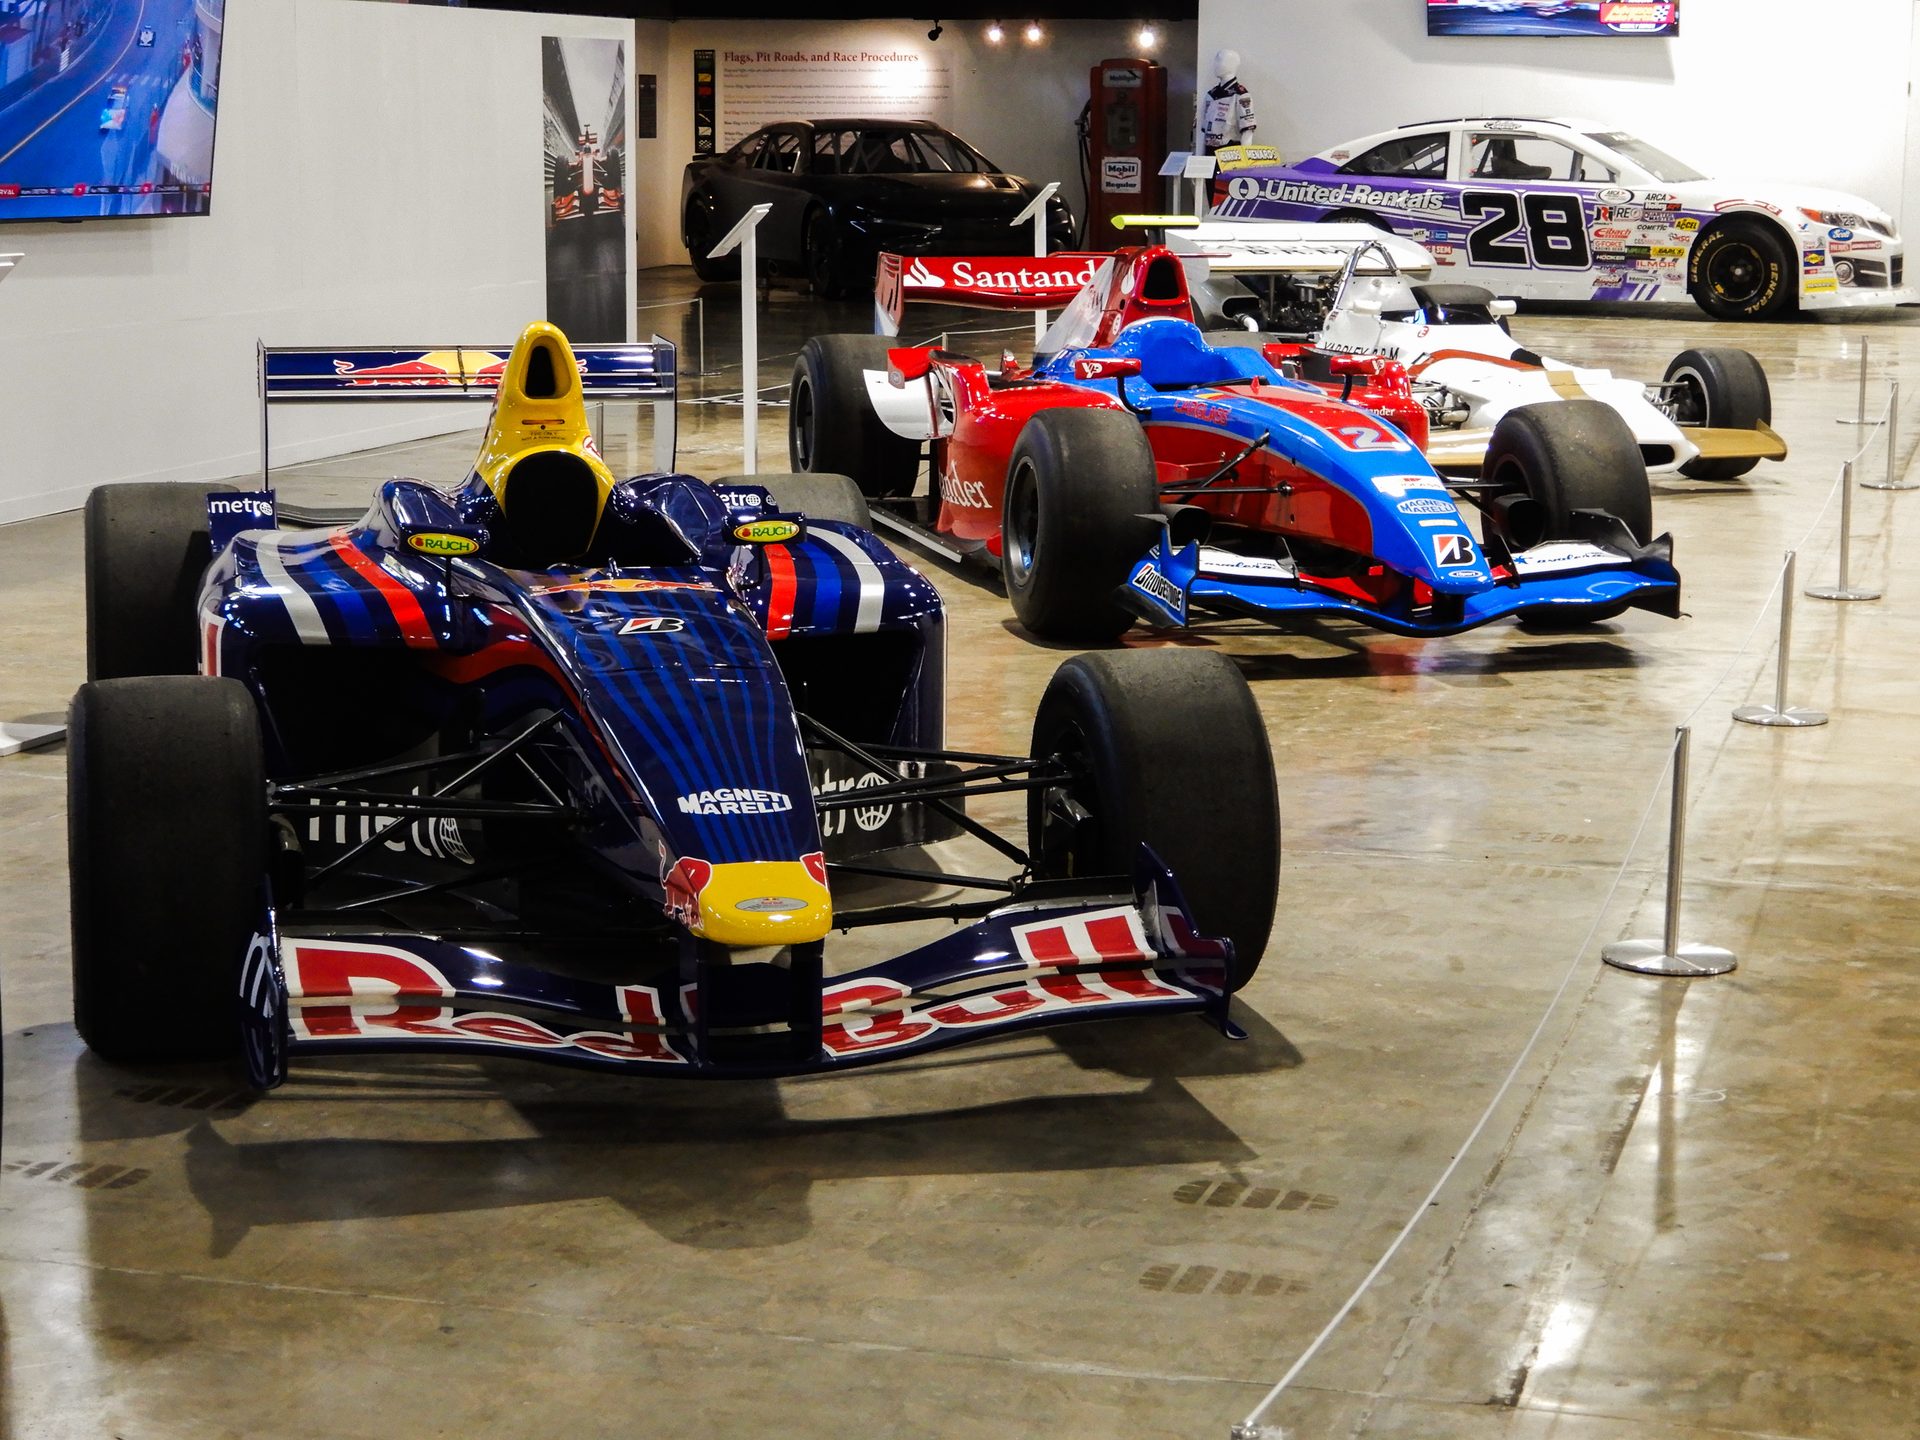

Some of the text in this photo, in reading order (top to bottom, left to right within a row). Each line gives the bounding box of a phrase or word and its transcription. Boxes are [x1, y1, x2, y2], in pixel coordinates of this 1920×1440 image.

[724, 51, 753, 64] Flags,
[756, 51, 770, 62] Pit
[774, 51, 808, 63] Roads,
[810, 51, 830, 62] and
[833, 51, 858, 62] Race
[861, 51, 919, 62] Procedures
[1108, 164, 1135, 173] Mobil
[1105, 181, 1137, 189] Regular
[1265, 180, 1445, 210] United Rentals
[1644, 193, 1667, 201] ARCA
[1461, 189, 1593, 269] 28
[1594, 228, 1631, 238] Eibach
[1675, 220, 1697, 230] ACCEL
[1636, 260, 1676, 268] ILMOR
[1690, 231, 1724, 283] GENERAL
[952, 260, 1096, 288] Santand
[1744, 262, 1779, 314] GENERAL
[1174, 399, 1232, 426] CARGLASS
[1340, 427, 1397, 448] 2
[753, 526, 793, 537] RAUCH
[425, 539, 471, 551] RAUCH
[678, 788, 791, 806] MAGNETI
[679, 798, 793, 815] MARELLI
[281, 936, 689, 1064] Red
[822, 905, 1198, 1057] Bull
